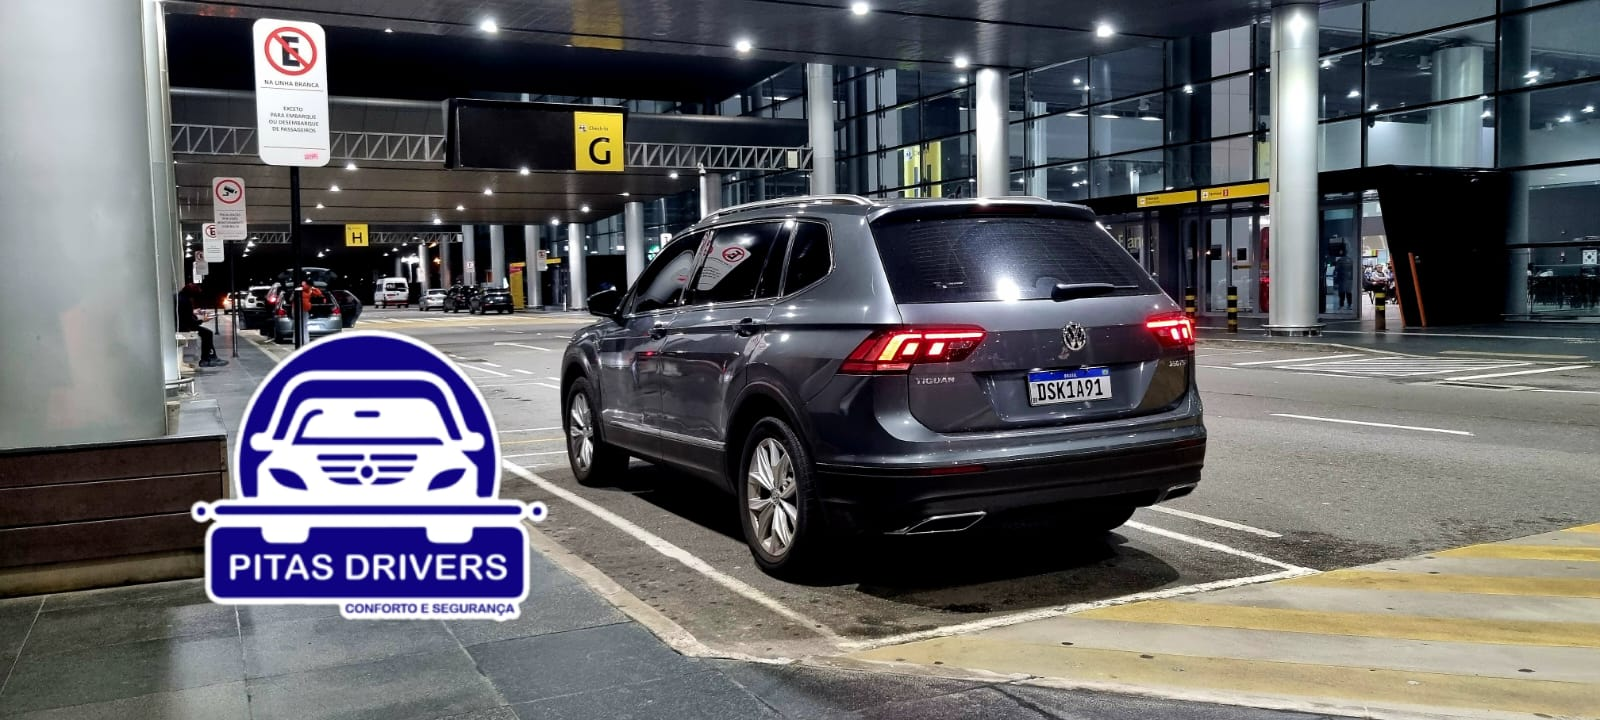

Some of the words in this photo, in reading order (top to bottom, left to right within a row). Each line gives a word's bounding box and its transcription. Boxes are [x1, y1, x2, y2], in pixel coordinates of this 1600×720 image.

[589, 137, 611, 165] G
[352, 231, 363, 244] H
[915, 376, 955, 385] TIGUAN
[1036, 378, 1104, 401] DSK1A91
